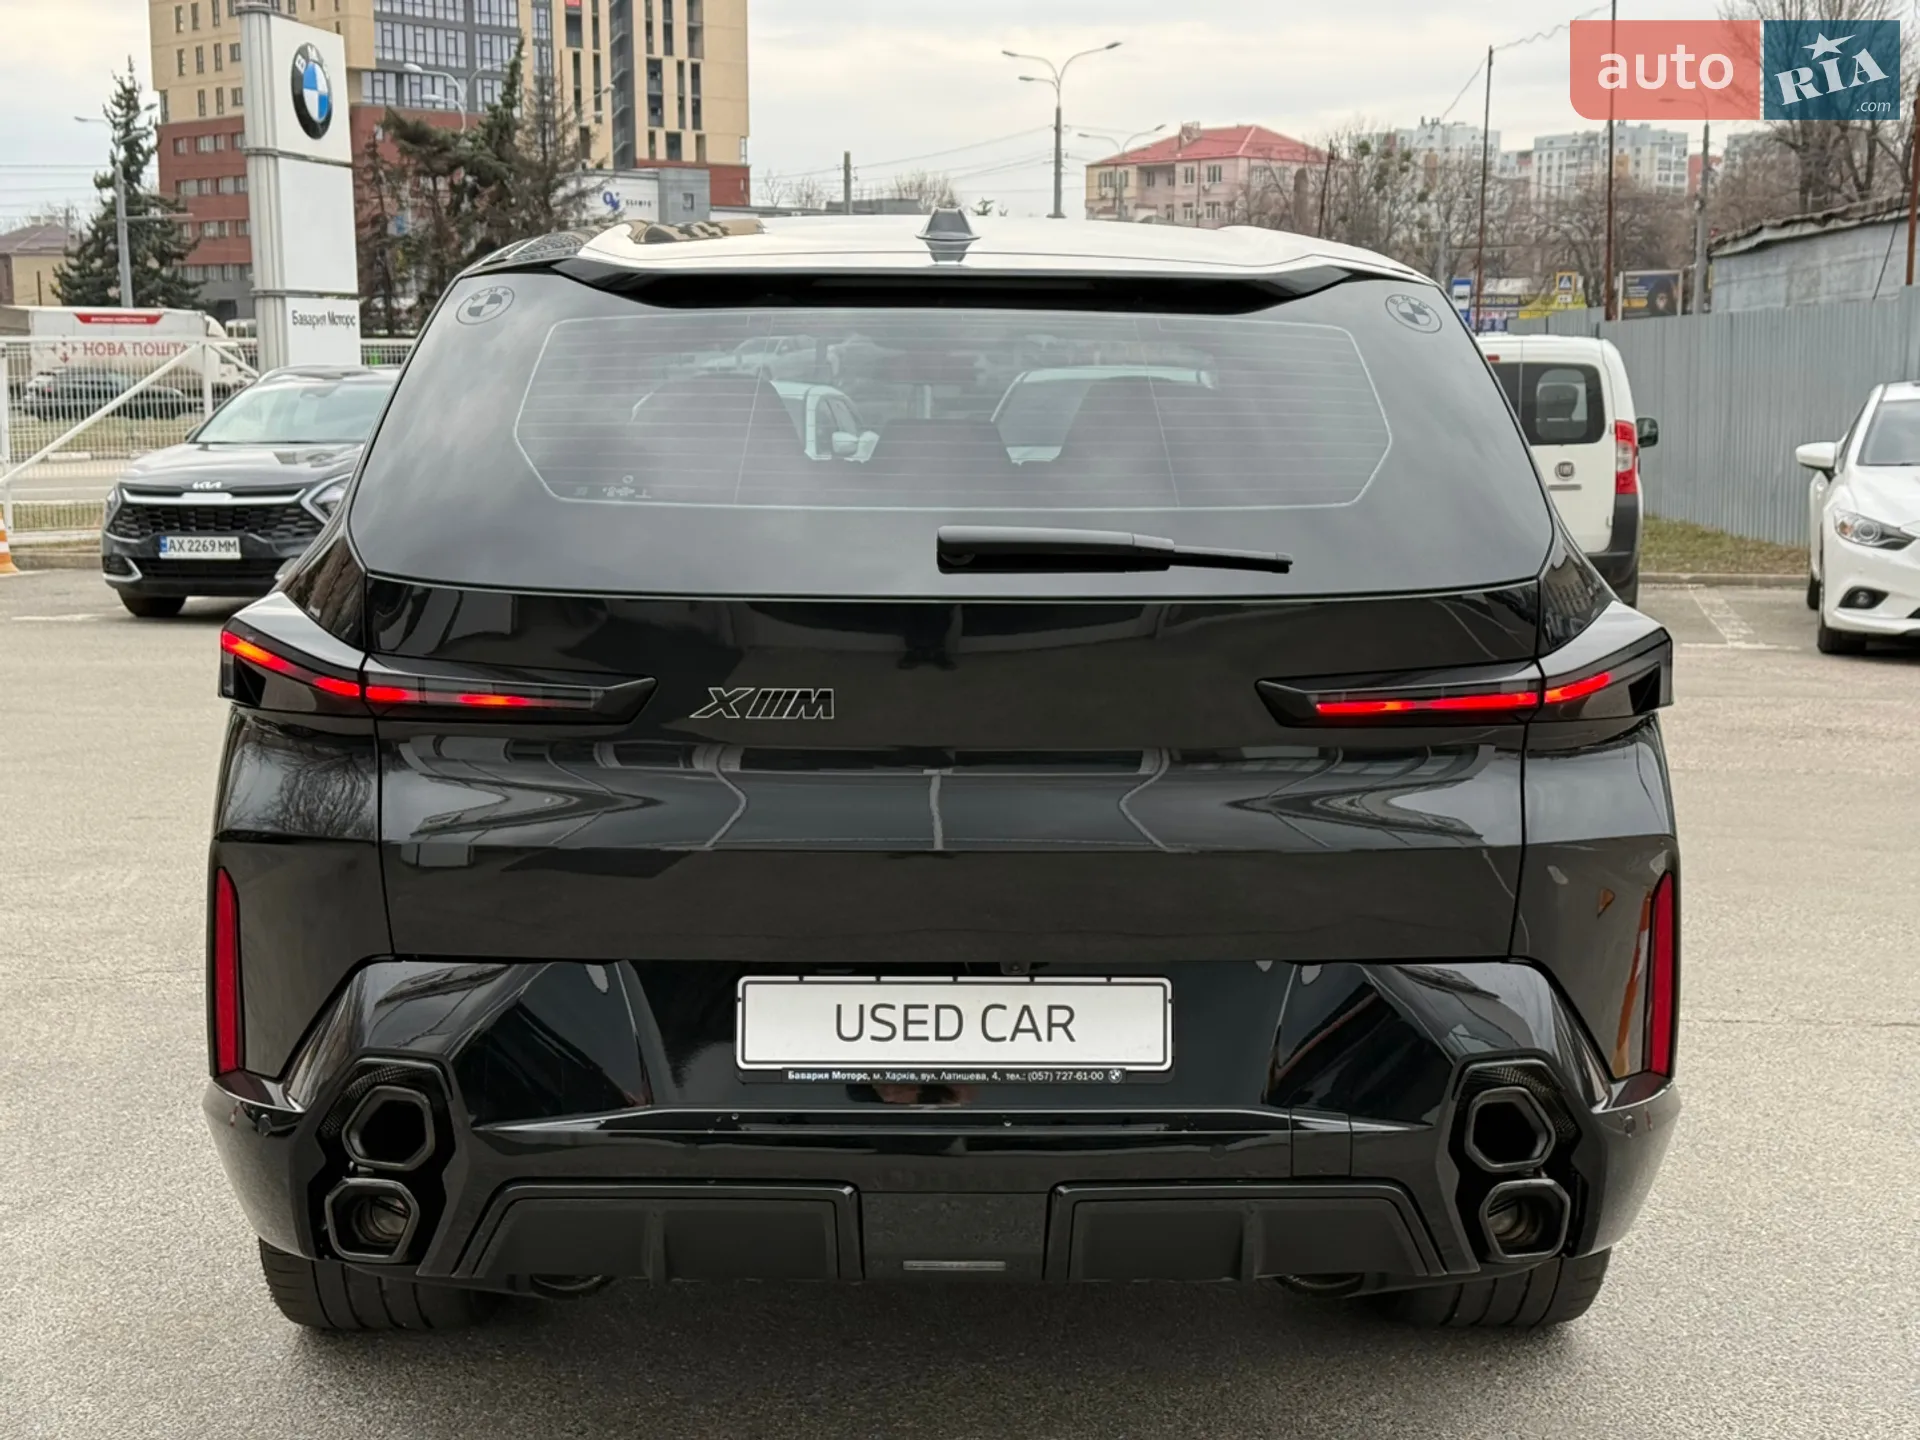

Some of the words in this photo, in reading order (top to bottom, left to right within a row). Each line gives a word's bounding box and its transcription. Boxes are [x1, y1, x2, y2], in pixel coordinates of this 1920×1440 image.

[292, 310, 326, 330] Бавария
[327, 310, 356, 329] Моторс
[83, 342, 128, 357] НОВА
[168, 539, 186, 553] AX
[187, 539, 216, 553] 2269
[217, 539, 237, 553] MM
[836, 1003, 964, 1042] USED
[980, 1003, 1076, 1042] CAR
[787, 1070, 830, 1082] Бавария
[831, 1070, 871, 1081] Моторс,
[920, 1073, 938, 1083] вул.
[940, 1071, 990, 1082] Латишева,
[1027, 1070, 1053, 1083] (057)
[1055, 1071, 1104, 1081] 727-61-00
